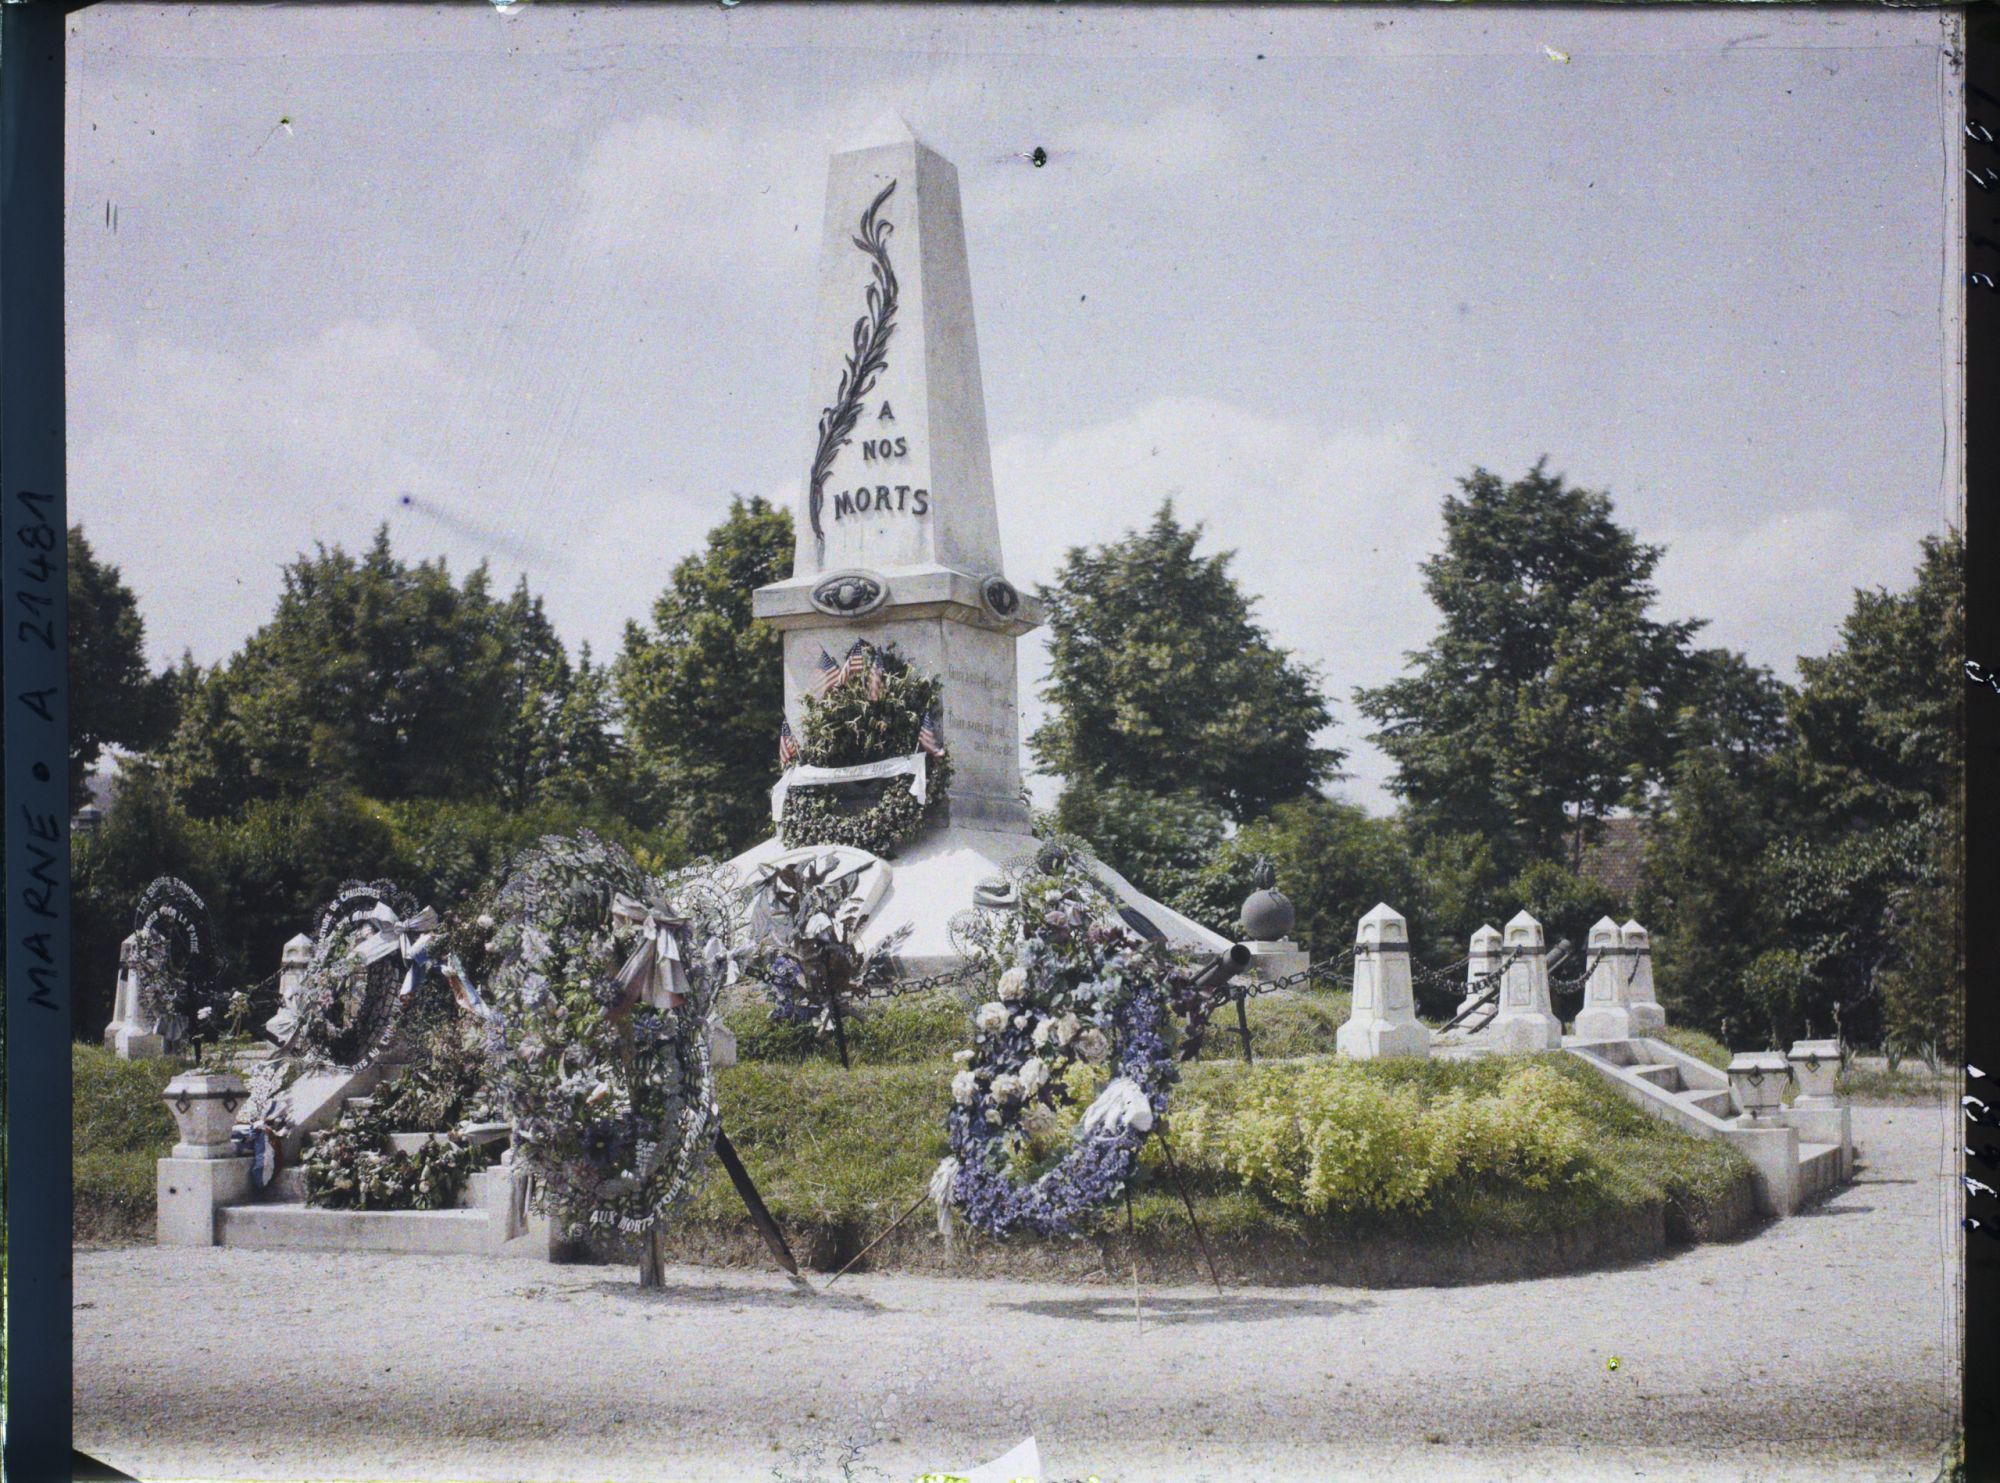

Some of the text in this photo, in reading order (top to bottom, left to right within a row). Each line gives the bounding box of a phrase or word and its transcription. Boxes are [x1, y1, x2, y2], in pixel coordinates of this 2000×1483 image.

[878, 400, 895, 419] A
[863, 436, 907, 460] NOS
[834, 485, 928, 520] MORTS
[17, 490, 61, 1012] MARNE A 21481
[590, 1210, 617, 1225] AUX
[618, 1214, 655, 1234] MORTS
